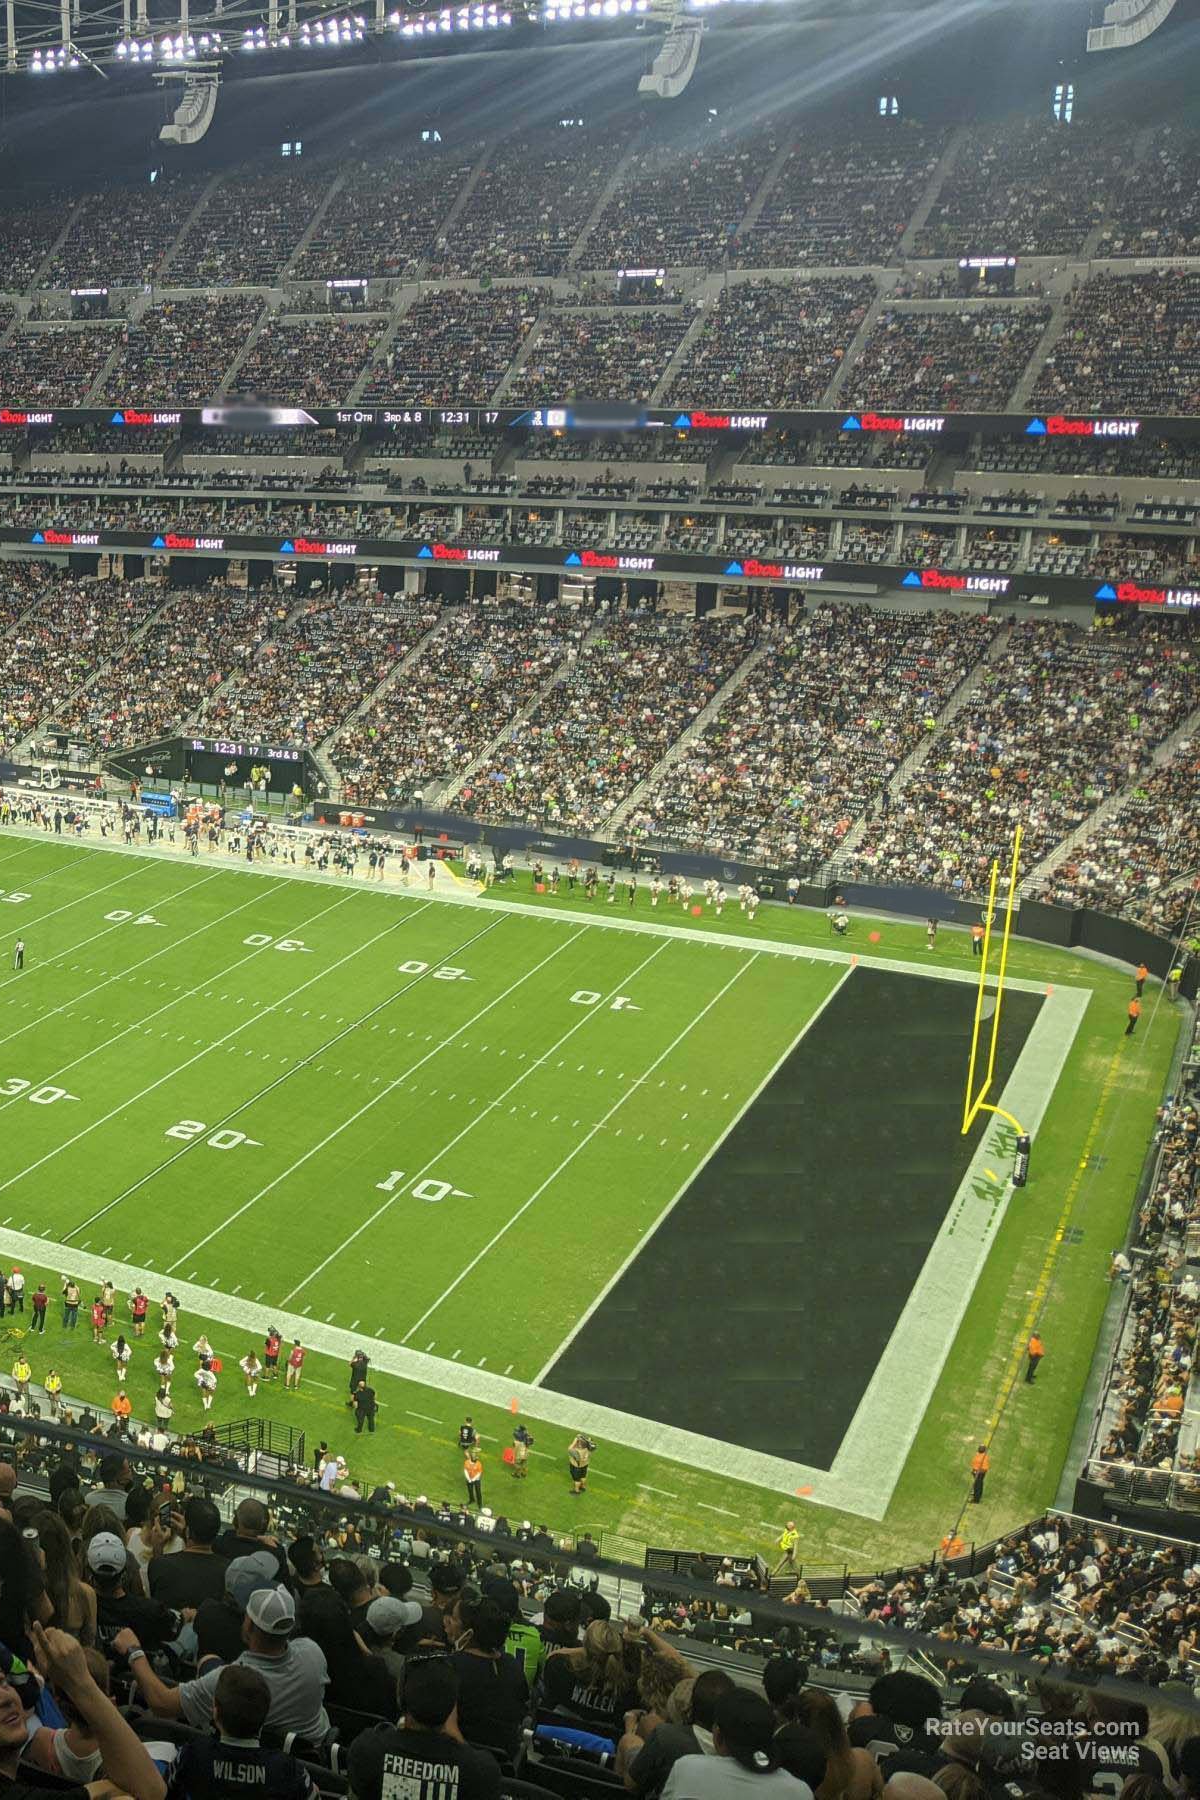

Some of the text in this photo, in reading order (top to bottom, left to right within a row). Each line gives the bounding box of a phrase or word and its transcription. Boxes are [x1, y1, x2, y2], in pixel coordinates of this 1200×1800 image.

[27, 412, 53, 424] LIGHT
[153, 412, 180, 424] LIGHT
[336, 411, 373, 423] 1ST QTR
[383, 411, 422, 423] 3RD & 8
[440, 411, 470, 423] 12:31
[485, 411, 499, 423] 17
[728, 416, 767, 430] LIGHT
[903, 418, 945, 432] LIGHT
[1093, 421, 1140, 436] LIGHT
[43, 529, 99, 545] Coors LIGHT
[165, 533, 225, 550] Coors LIGHT
[294, 538, 357, 555] Coors LIGHT
[432, 543, 500, 561] Coors LIGHT
[581, 550, 655, 570] Coors LIGHT
[743, 559, 824, 580] Coors LIGHT
[921, 569, 1011, 592] Coors LIGHT
[1116, 583, 1167, 603] Coors
[214, 742, 243, 755] 12:31
[248, 746, 259, 756] 17
[267, 748, 283, 759] 3rd
[284, 751, 290, 759] &
[103, 910, 157, 925] 40
[243, 933, 305, 952] 30
[397, 960, 466, 981] 20
[569, 990, 631, 1010] 10
[164, 1120, 247, 1150] 20
[375, 1170, 453, 1202] 10
[571, 1685, 616, 1713] WALLER
[213, 1759, 267, 1785] WILSON
[382, 1752, 460, 1785] FREEDOM
